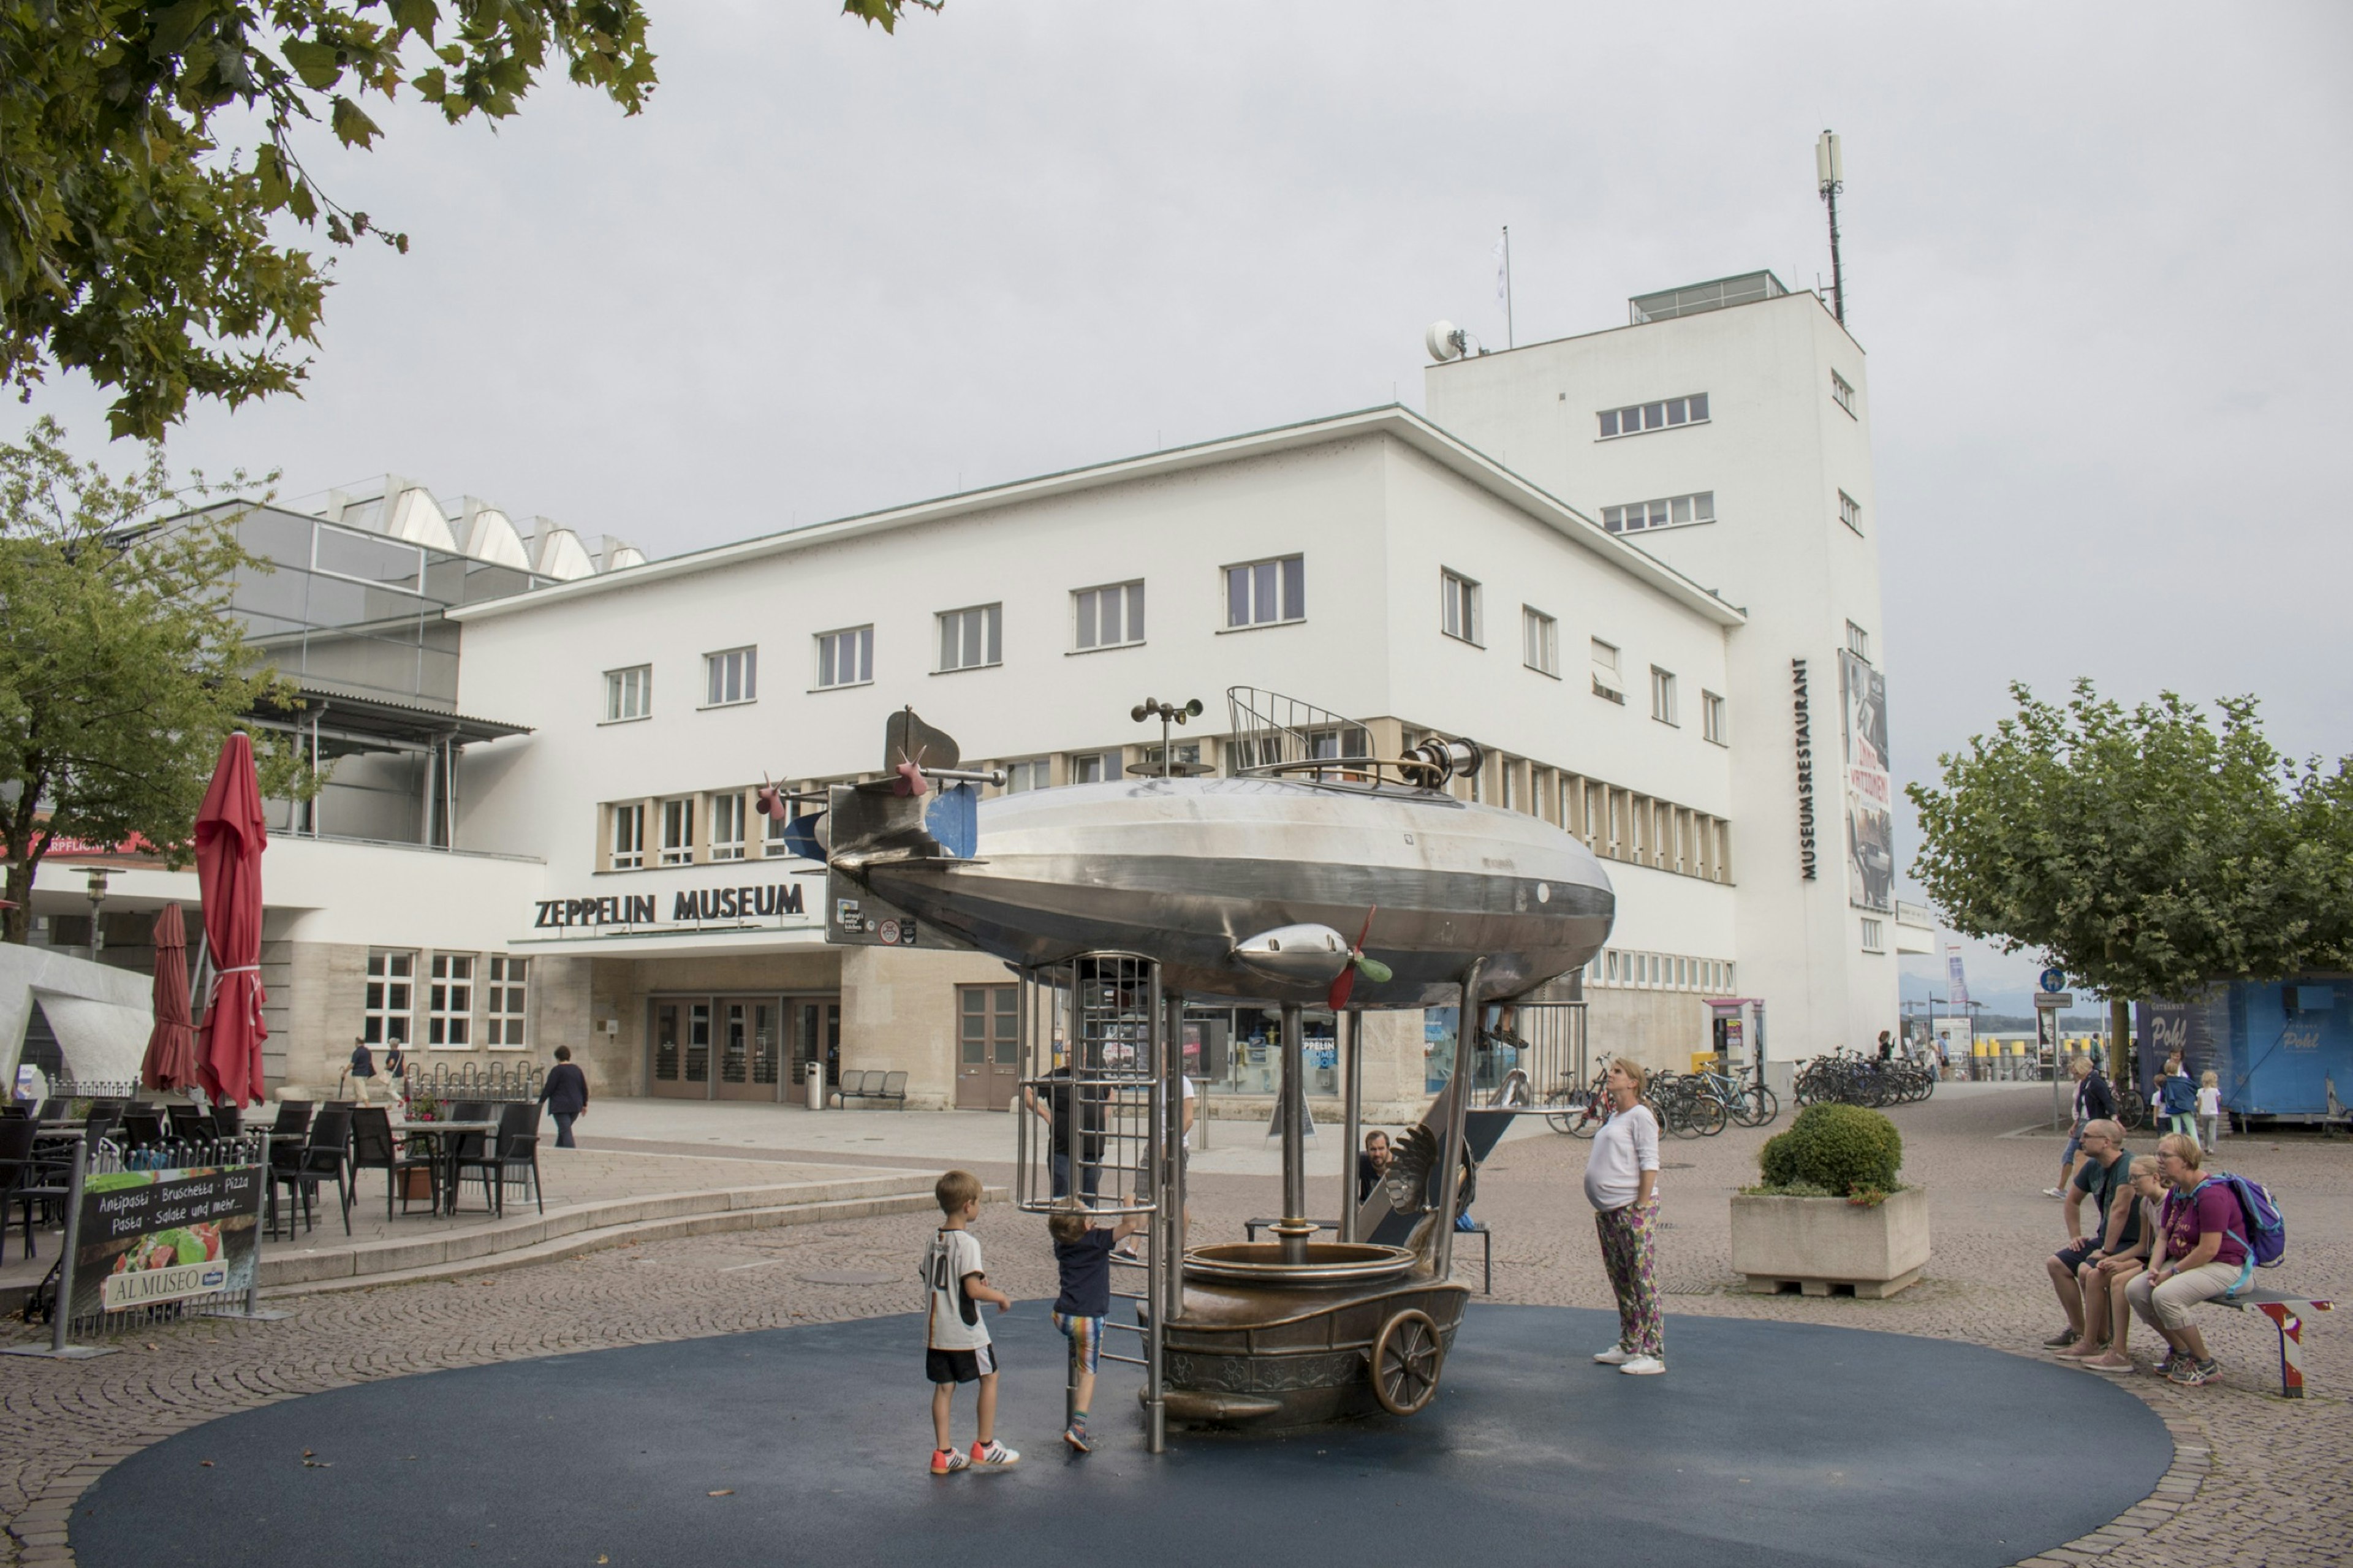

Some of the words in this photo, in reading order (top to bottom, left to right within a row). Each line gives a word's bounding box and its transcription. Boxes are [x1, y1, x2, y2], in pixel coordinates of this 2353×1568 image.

[1792, 658, 1816, 881] MUSEUMSRESTAURANT
[534, 895, 656, 928] ZEPPELIN
[672, 883, 805, 920] MUSEUM
[1302, 1041, 1335, 1050] PPELIN
[2151, 1017, 2187, 1047] Pohl
[2283, 1031, 2320, 1049] Pohl
[99, 1191, 149, 1216] Antipasti
[162, 1183, 214, 1202] Bruschetta
[224, 1176, 248, 1194] Pizza
[112, 1216, 142, 1236] Pasta
[155, 1207, 186, 1224] Salate
[191, 1201, 208, 1218] und
[212, 1198, 243, 1213] mehr...
[114, 1279, 137, 1301] AL
[140, 1269, 199, 1297] MUSEO
[928, 1252, 949, 1292] 10
